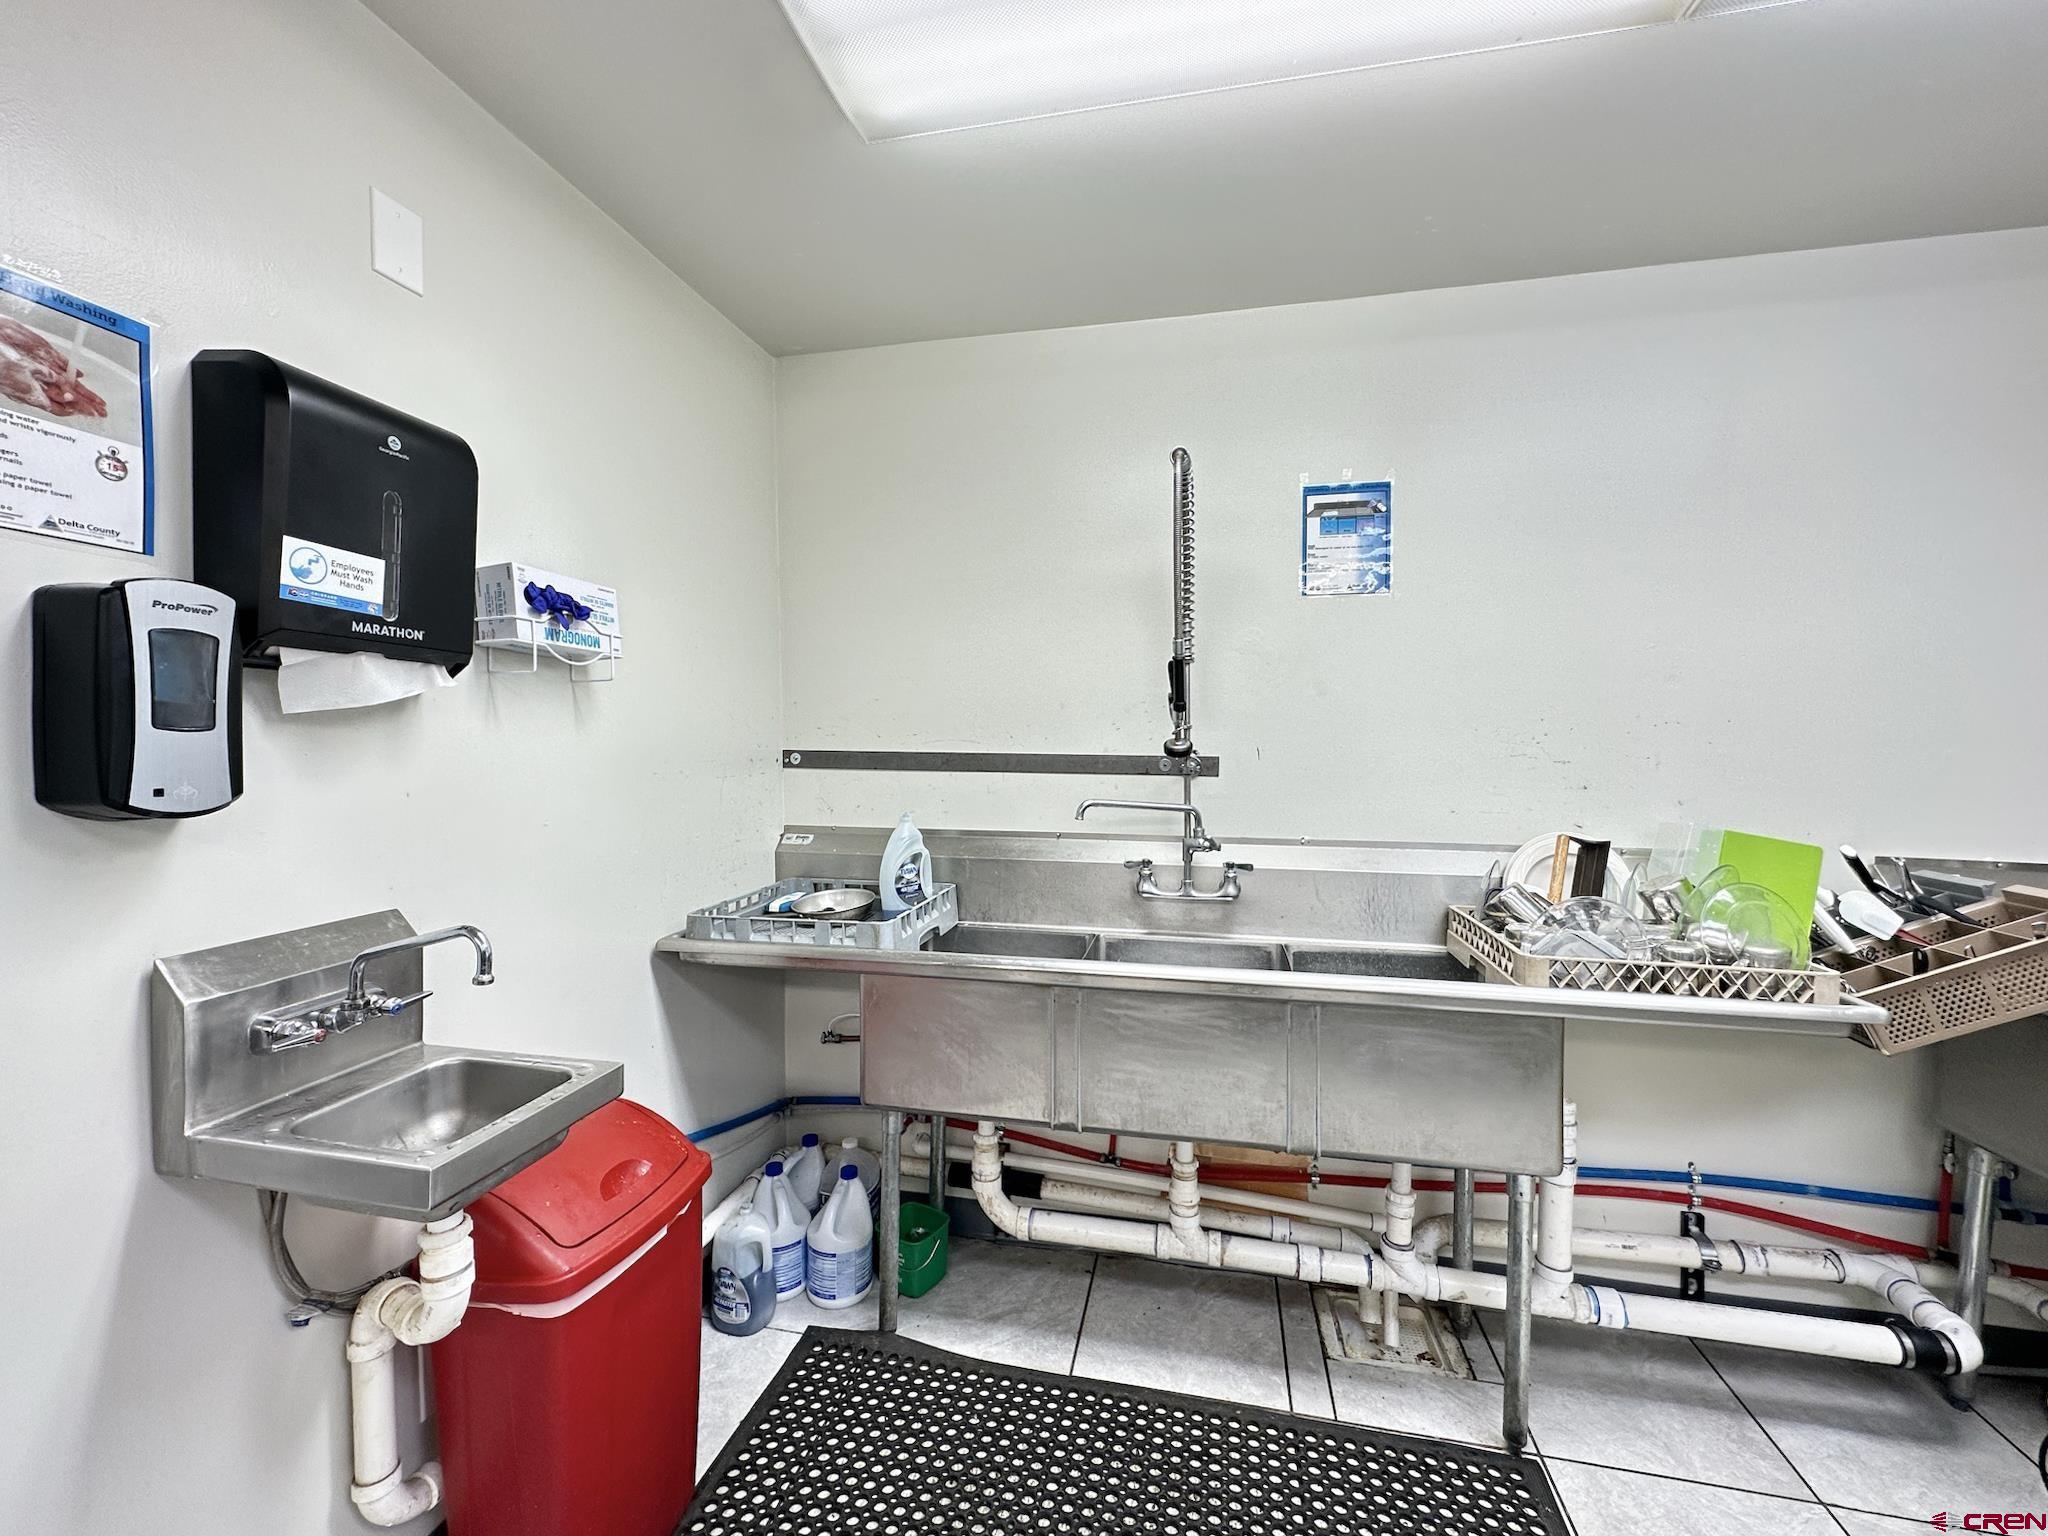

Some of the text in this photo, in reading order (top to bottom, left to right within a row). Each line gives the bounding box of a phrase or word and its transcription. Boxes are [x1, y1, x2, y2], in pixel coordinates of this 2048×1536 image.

[51, 292, 118, 326] Washing
[16, 414, 40, 424] water
[9, 420, 34, 431] wrists
[36, 428, 76, 443] vigorously
[3, 472, 52, 488] paper towel
[24, 485, 48, 493] paper
[50, 490, 72, 499] towel
[58, 518, 85, 530] Delta
[87, 524, 120, 537] County
[331, 560, 374, 577] Employees
[331, 569, 374, 585] Must Wash
[340, 580, 364, 591] Hands
[152, 600, 213, 616] ProPower
[352, 621, 422, 641] MARATHON
[544, 627, 601, 648] MONOGRAM
